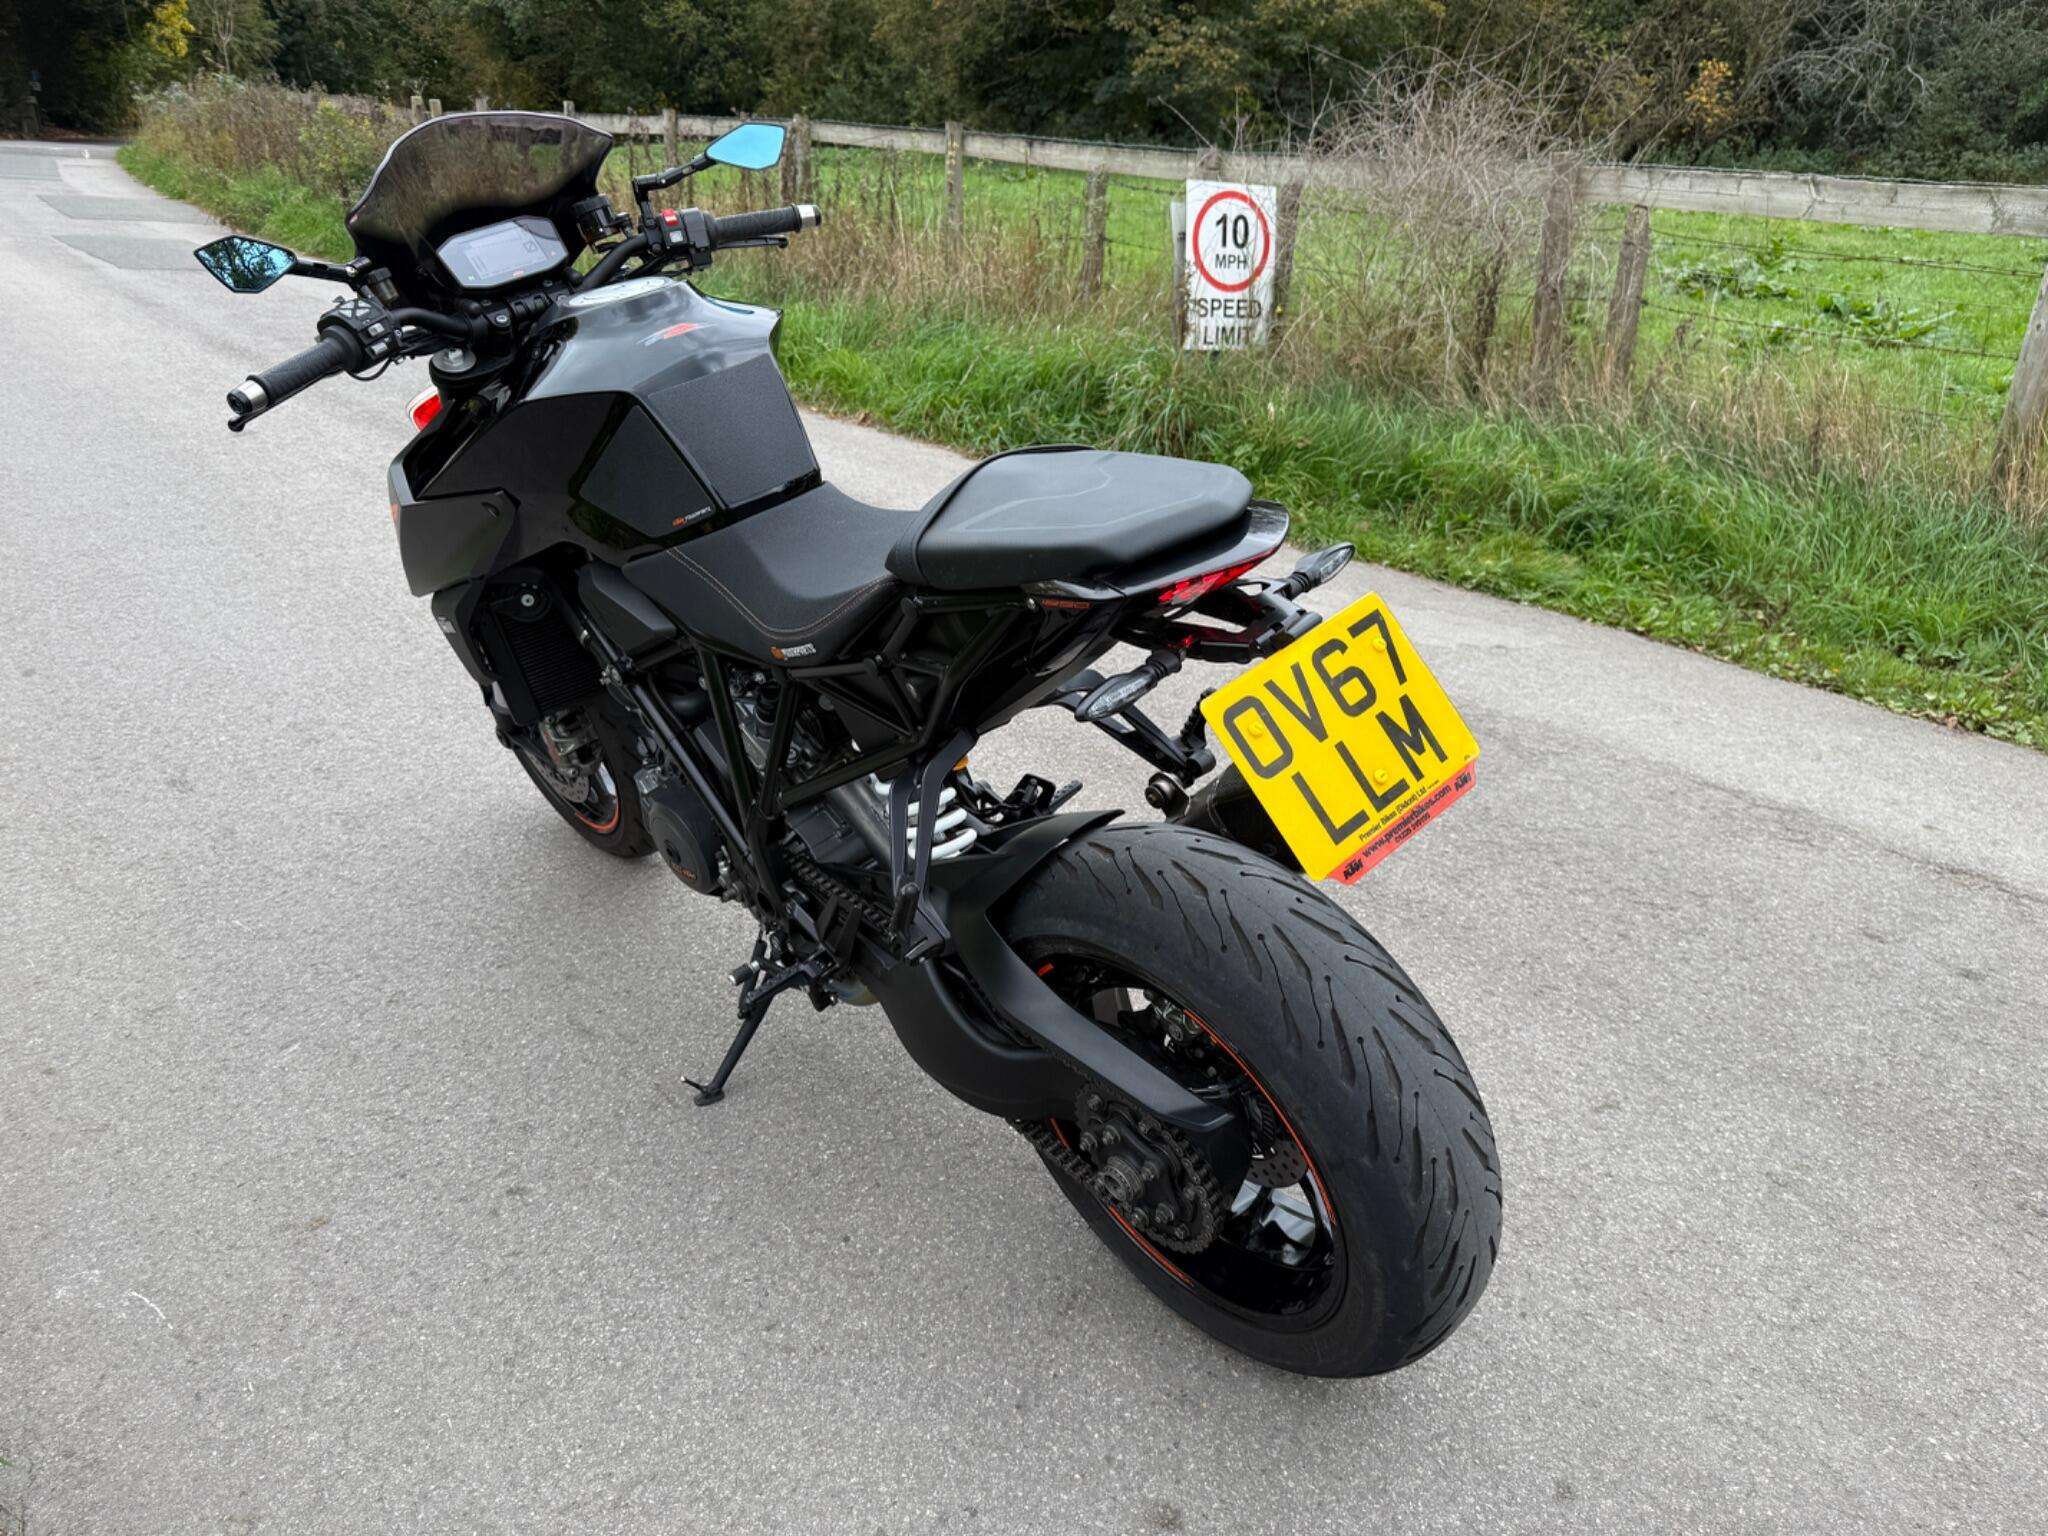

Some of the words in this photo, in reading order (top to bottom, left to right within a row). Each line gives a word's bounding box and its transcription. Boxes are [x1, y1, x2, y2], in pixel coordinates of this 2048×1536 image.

[1216, 213, 1249, 249] 10
[1214, 253, 1248, 270] MPH
[1198, 297, 1262, 319] SPEED
[1203, 325, 1255, 346] LIMIT
[1223, 609, 1407, 779] OV67
[1291, 694, 1448, 846] LLM
